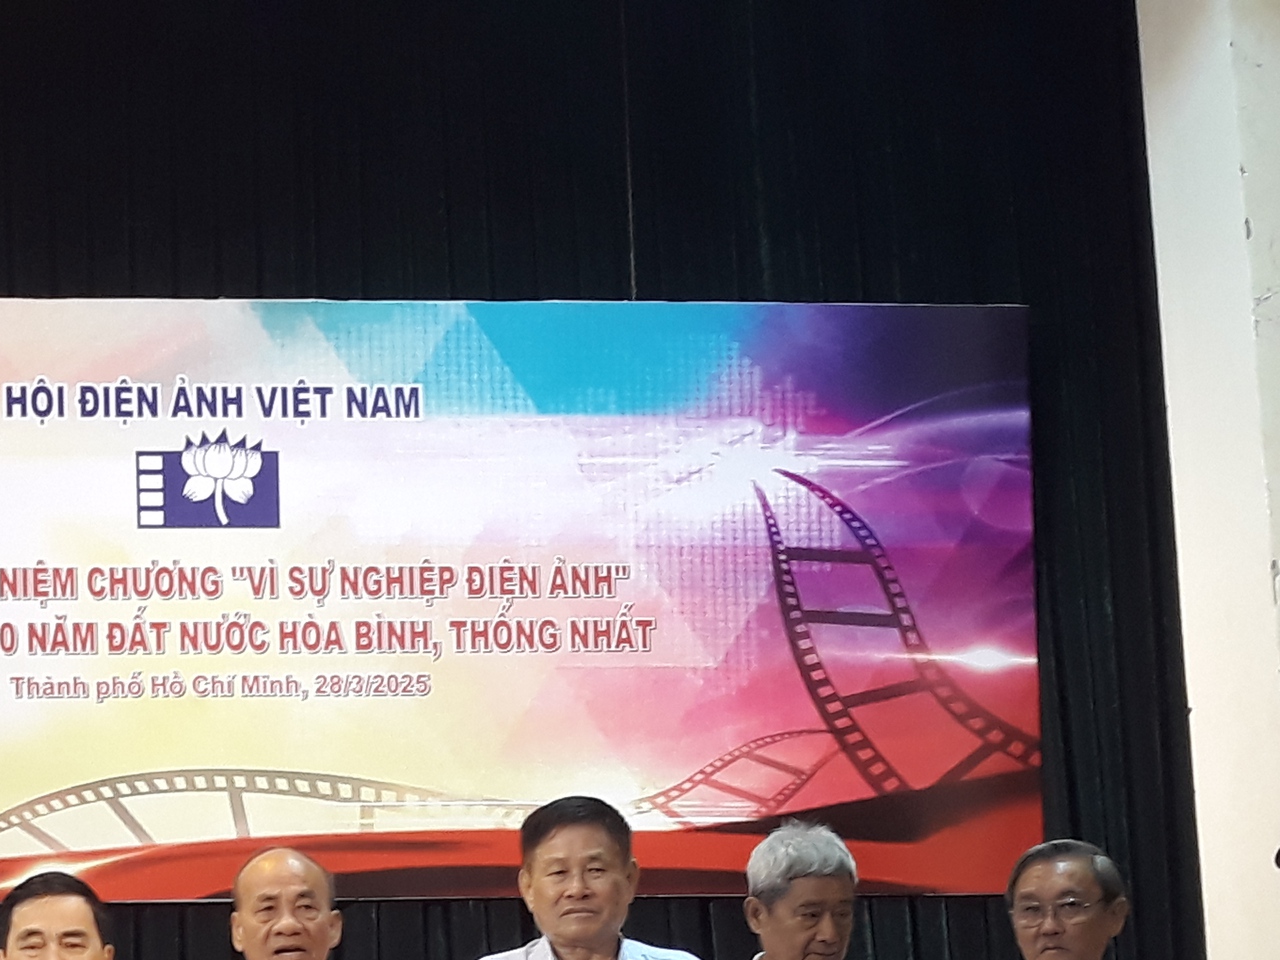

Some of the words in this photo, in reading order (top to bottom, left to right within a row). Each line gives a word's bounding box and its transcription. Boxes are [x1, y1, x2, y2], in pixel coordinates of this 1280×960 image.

[6, 378, 64, 425] HỘI
[78, 378, 158, 425] ĐIỆN
[171, 377, 243, 418] ẢNH
[255, 379, 333, 425] VIỆT
[346, 386, 421, 418] NAM
[87, 559, 223, 600] CHƯƠNG
[231, 558, 279, 600] "VÌ
[287, 557, 334, 607] SỰ
[339, 557, 458, 606] NGHIỆP
[465, 556, 541, 605] ĐIỆN
[547, 556, 630, 599] ẢNH"
[27, 614, 99, 656] NĂM
[106, 605, 171, 655] ĐẤT
[179, 611, 270, 655] NƯỚC
[278, 613, 348, 653] HÒA
[355, 613, 442, 662] BÌNH,
[449, 601, 561, 653] THỐNG
[569, 602, 657, 653] NHẤT
[9, 676, 89, 699] Thành
[96, 671, 145, 704] phố
[151, 671, 186, 698] Hồ
[192, 674, 237, 697] Chí
[314, 674, 431, 697] 28/3/2025
